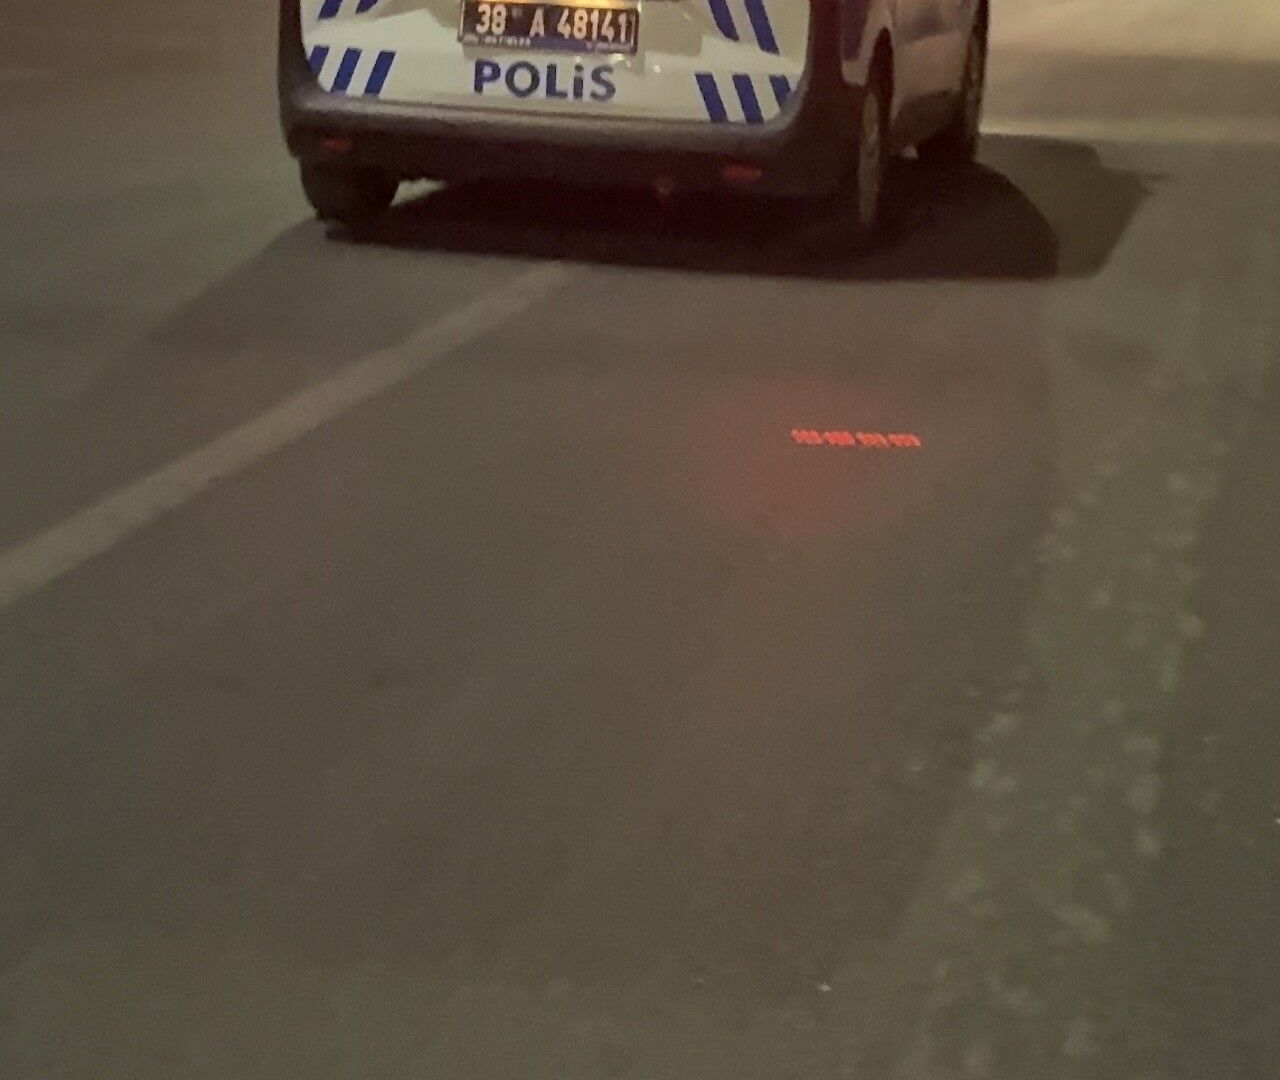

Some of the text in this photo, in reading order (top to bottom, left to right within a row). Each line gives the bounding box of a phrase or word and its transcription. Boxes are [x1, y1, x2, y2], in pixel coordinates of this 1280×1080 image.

[476, 3, 508, 36] 38
[529, 7, 546, 38] A
[556, 8, 628, 43] 48141
